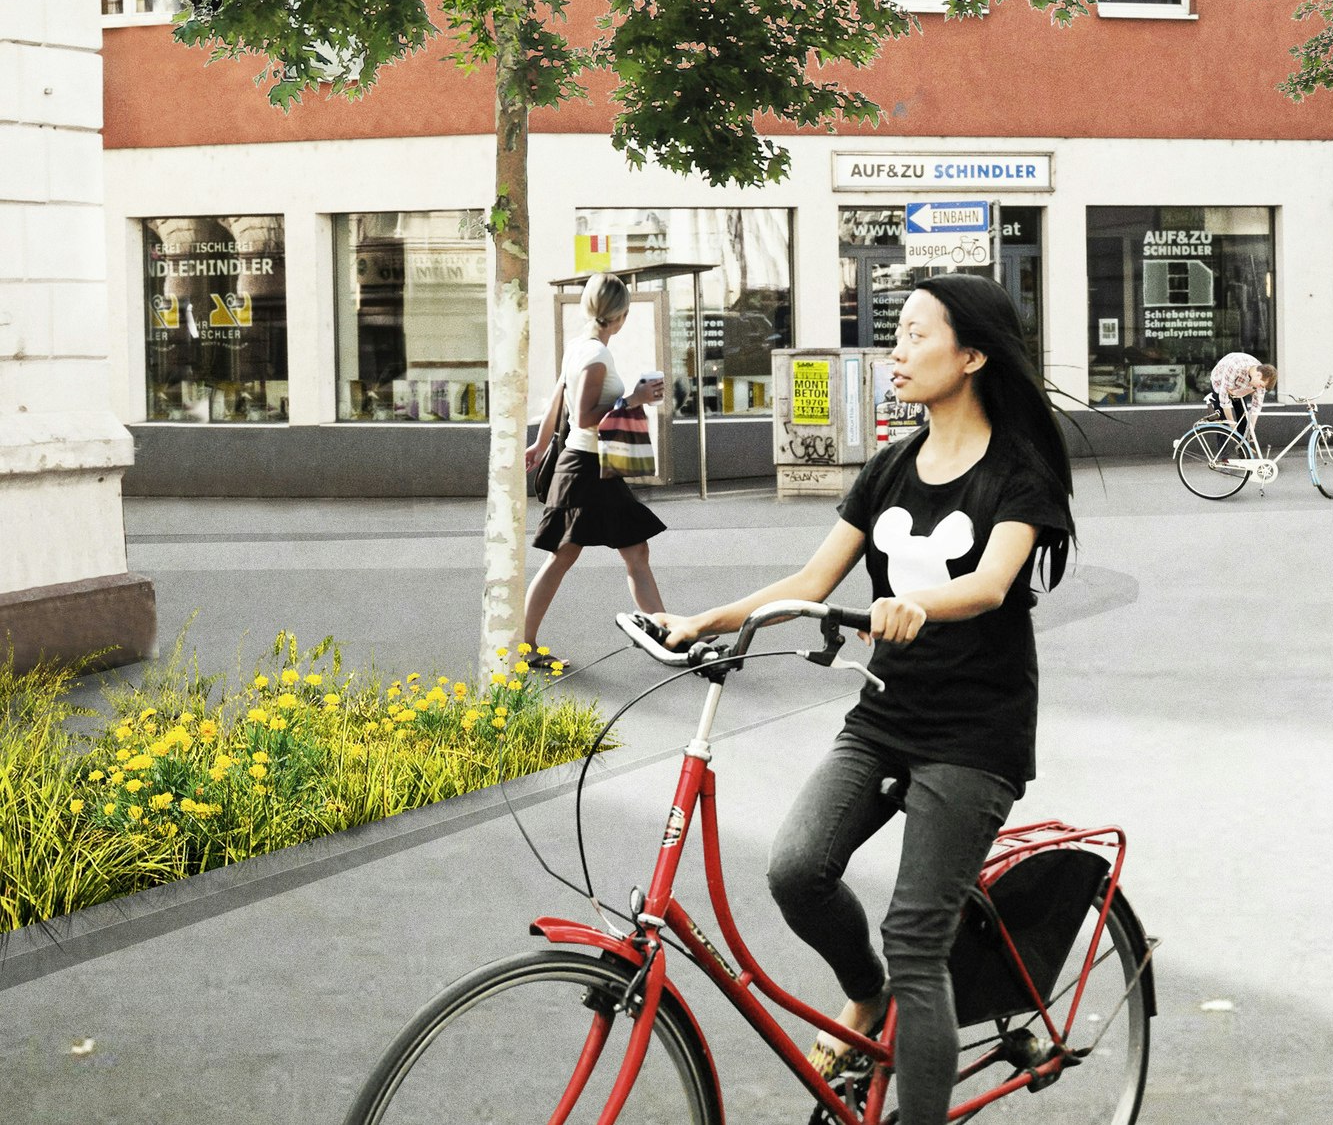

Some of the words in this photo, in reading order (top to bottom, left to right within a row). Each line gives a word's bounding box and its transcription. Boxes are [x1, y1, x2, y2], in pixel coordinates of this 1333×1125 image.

[850, 163, 925, 178] AUF&ZU
[934, 163, 1037, 179] SCHINDLER
[932, 210, 979, 224] EINBAHN
[1143, 231, 1212, 244] AUF&ZU
[909, 244, 951, 259] ausgen.
[1143, 245, 1212, 256] SCHINDLER
[1144, 310, 1213, 319] Schiebetüren
[1144, 320, 1213, 328] Schrankräume
[1144, 329, 1213, 339] Regalsysteme
[794, 380, 829, 389] MONTI
[794, 389, 829, 398] BETON
